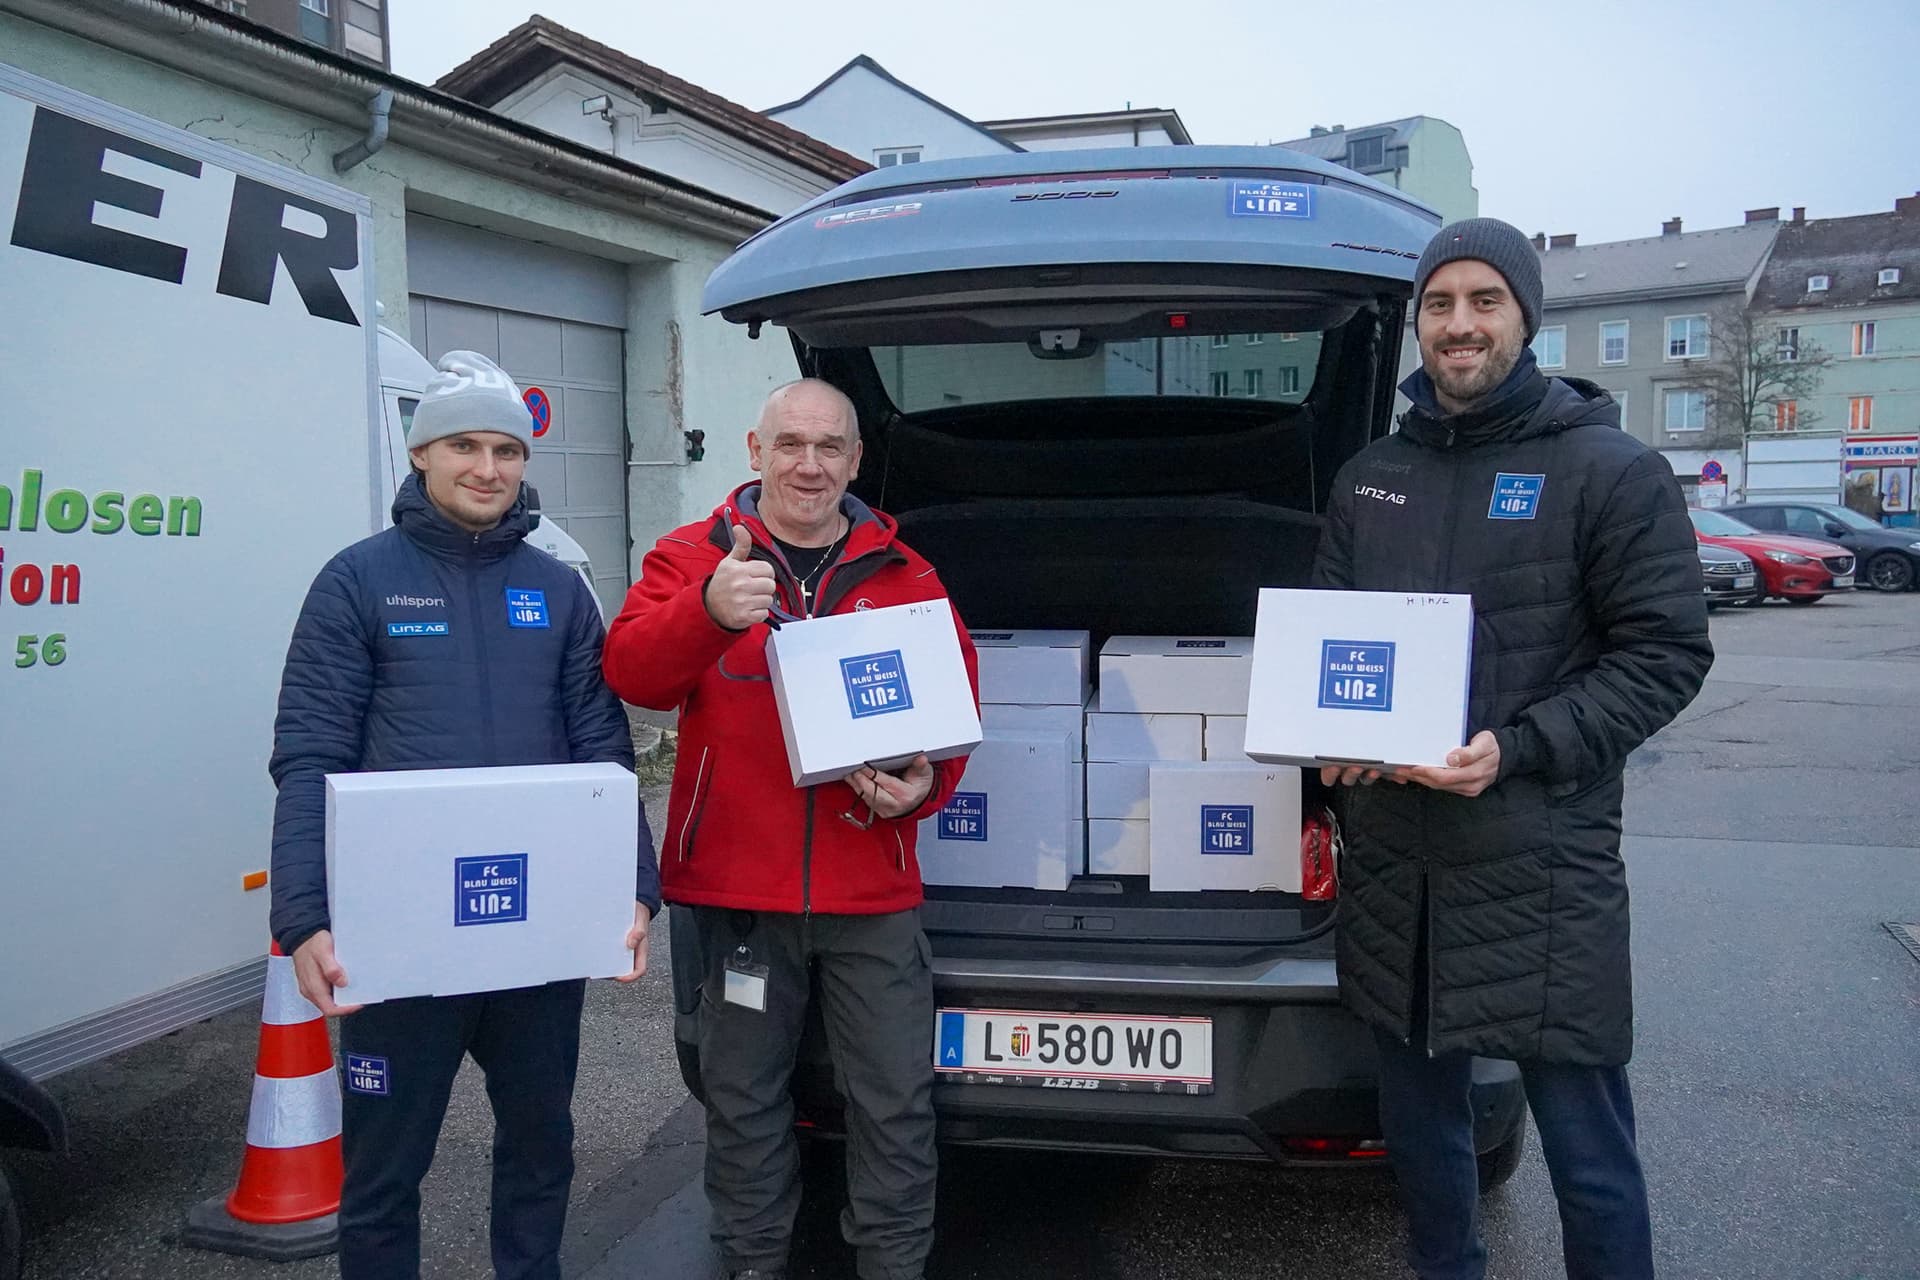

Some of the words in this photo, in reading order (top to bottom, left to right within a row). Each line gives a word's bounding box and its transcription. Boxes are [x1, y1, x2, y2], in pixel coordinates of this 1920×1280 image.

[10, 104, 361, 327] ER
[1385, 493, 1407, 505] AG
[386, 595, 446, 609] uhlsport
[15, 633, 67, 669] 56
[1350, 651, 1365, 662] FC
[866, 662, 880, 673] FC
[1330, 663, 1354, 671] BLAU
[1356, 664, 1384, 673] WEISS
[851, 675, 872, 685] BLAU
[874, 671, 898, 681] WEISS
[860, 687, 898, 706] LINZ
[1334, 679, 1377, 701] LINZ
[957, 799, 968, 808] FC
[1221, 812, 1233, 821] FC
[948, 818, 977, 834] LINZ
[1211, 832, 1242, 848] LINZ
[483, 865, 499, 877] FC
[463, 879, 488, 889] BLAU
[490, 876, 518, 887] WEISS
[469, 893, 512, 915] LINZ
[945, 1047, 957, 1060] A
[984, 1020, 1004, 1062] L
[1038, 1022, 1114, 1067] 580
[1042, 1077, 1100, 1091] LEEB
